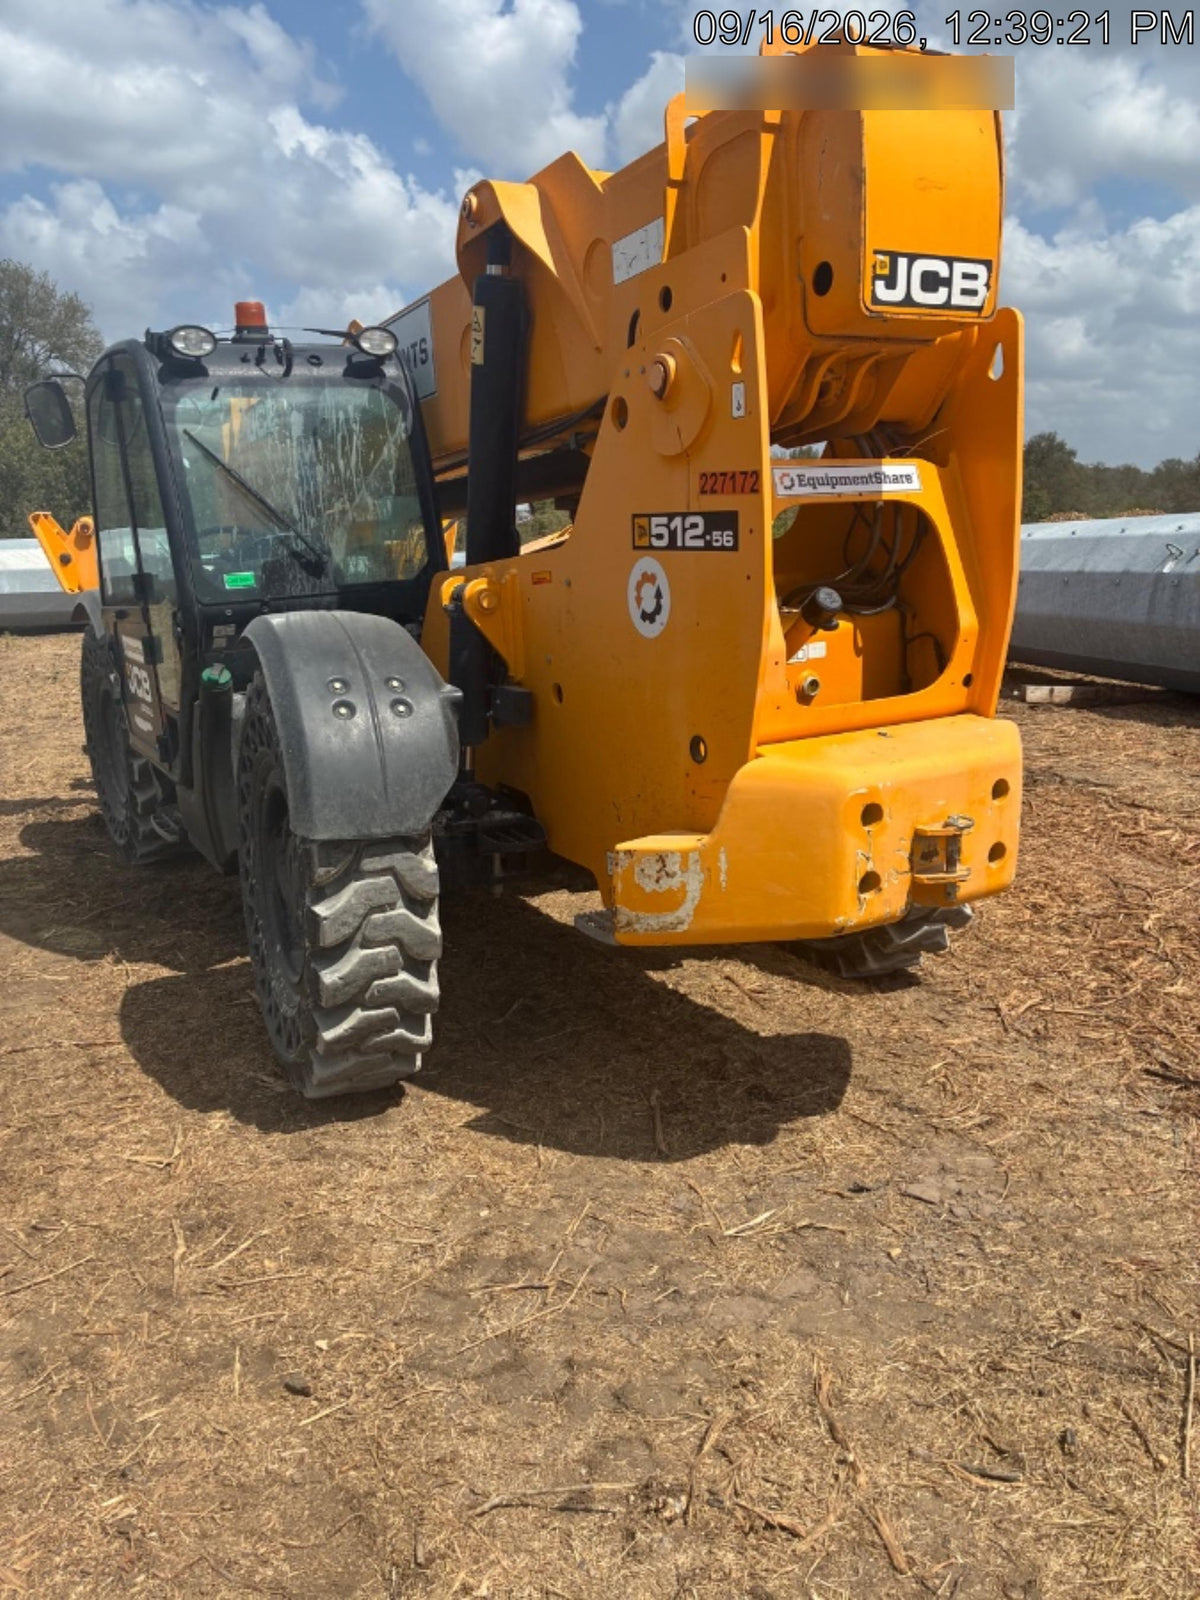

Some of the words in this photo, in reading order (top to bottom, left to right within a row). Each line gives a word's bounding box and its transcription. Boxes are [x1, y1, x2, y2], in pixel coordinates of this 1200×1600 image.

[874, 256, 988, 307] JCB
[699, 470, 760, 495] 227172
[796, 471, 914, 490] EquipmentShare
